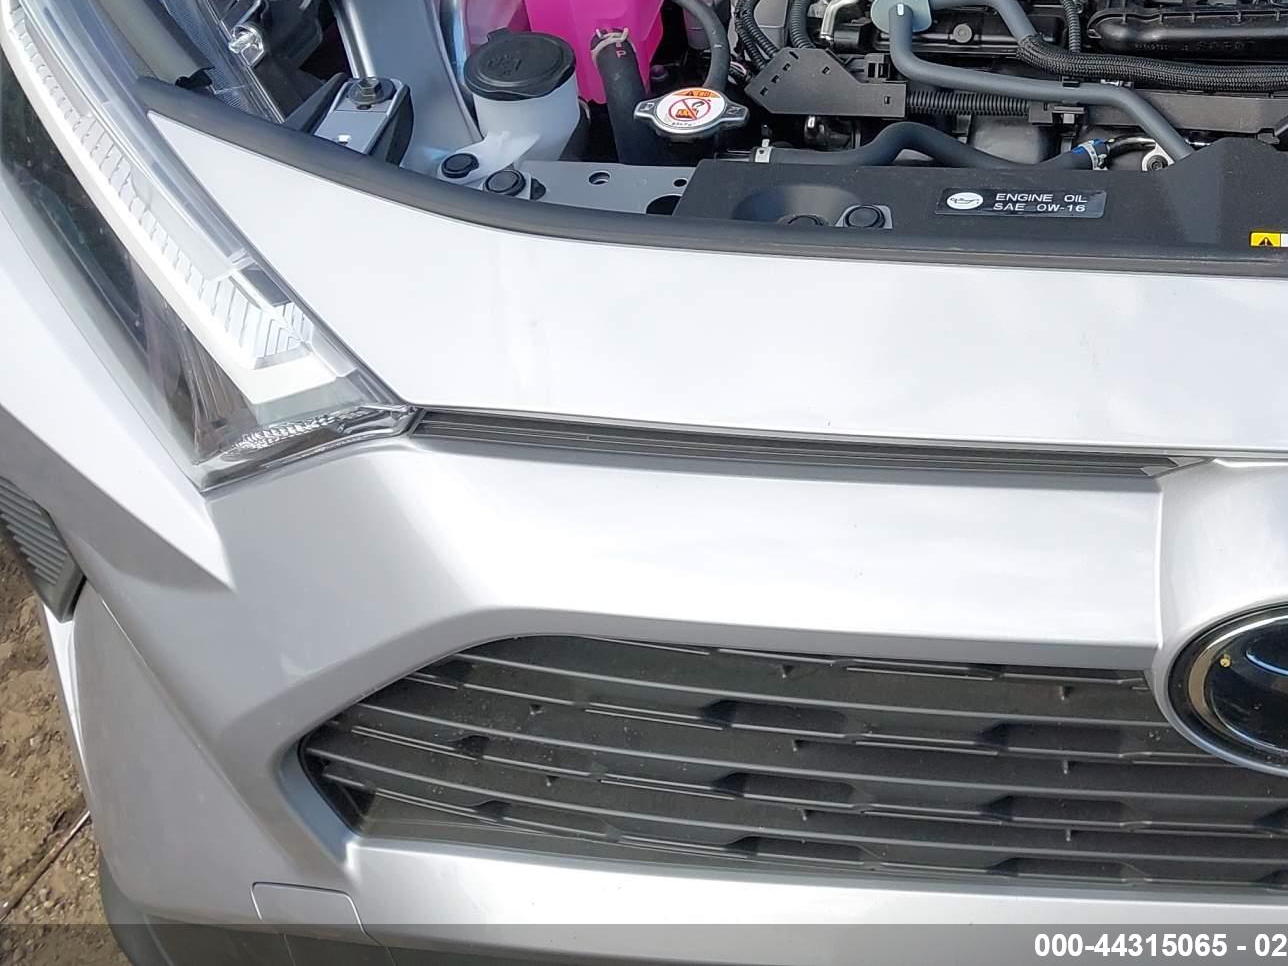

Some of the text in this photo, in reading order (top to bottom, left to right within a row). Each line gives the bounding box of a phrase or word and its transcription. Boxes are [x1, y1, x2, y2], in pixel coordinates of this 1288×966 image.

[995, 193, 1088, 203] ENGINE OIL
[993, 203, 1086, 213] SAE 0W-16
